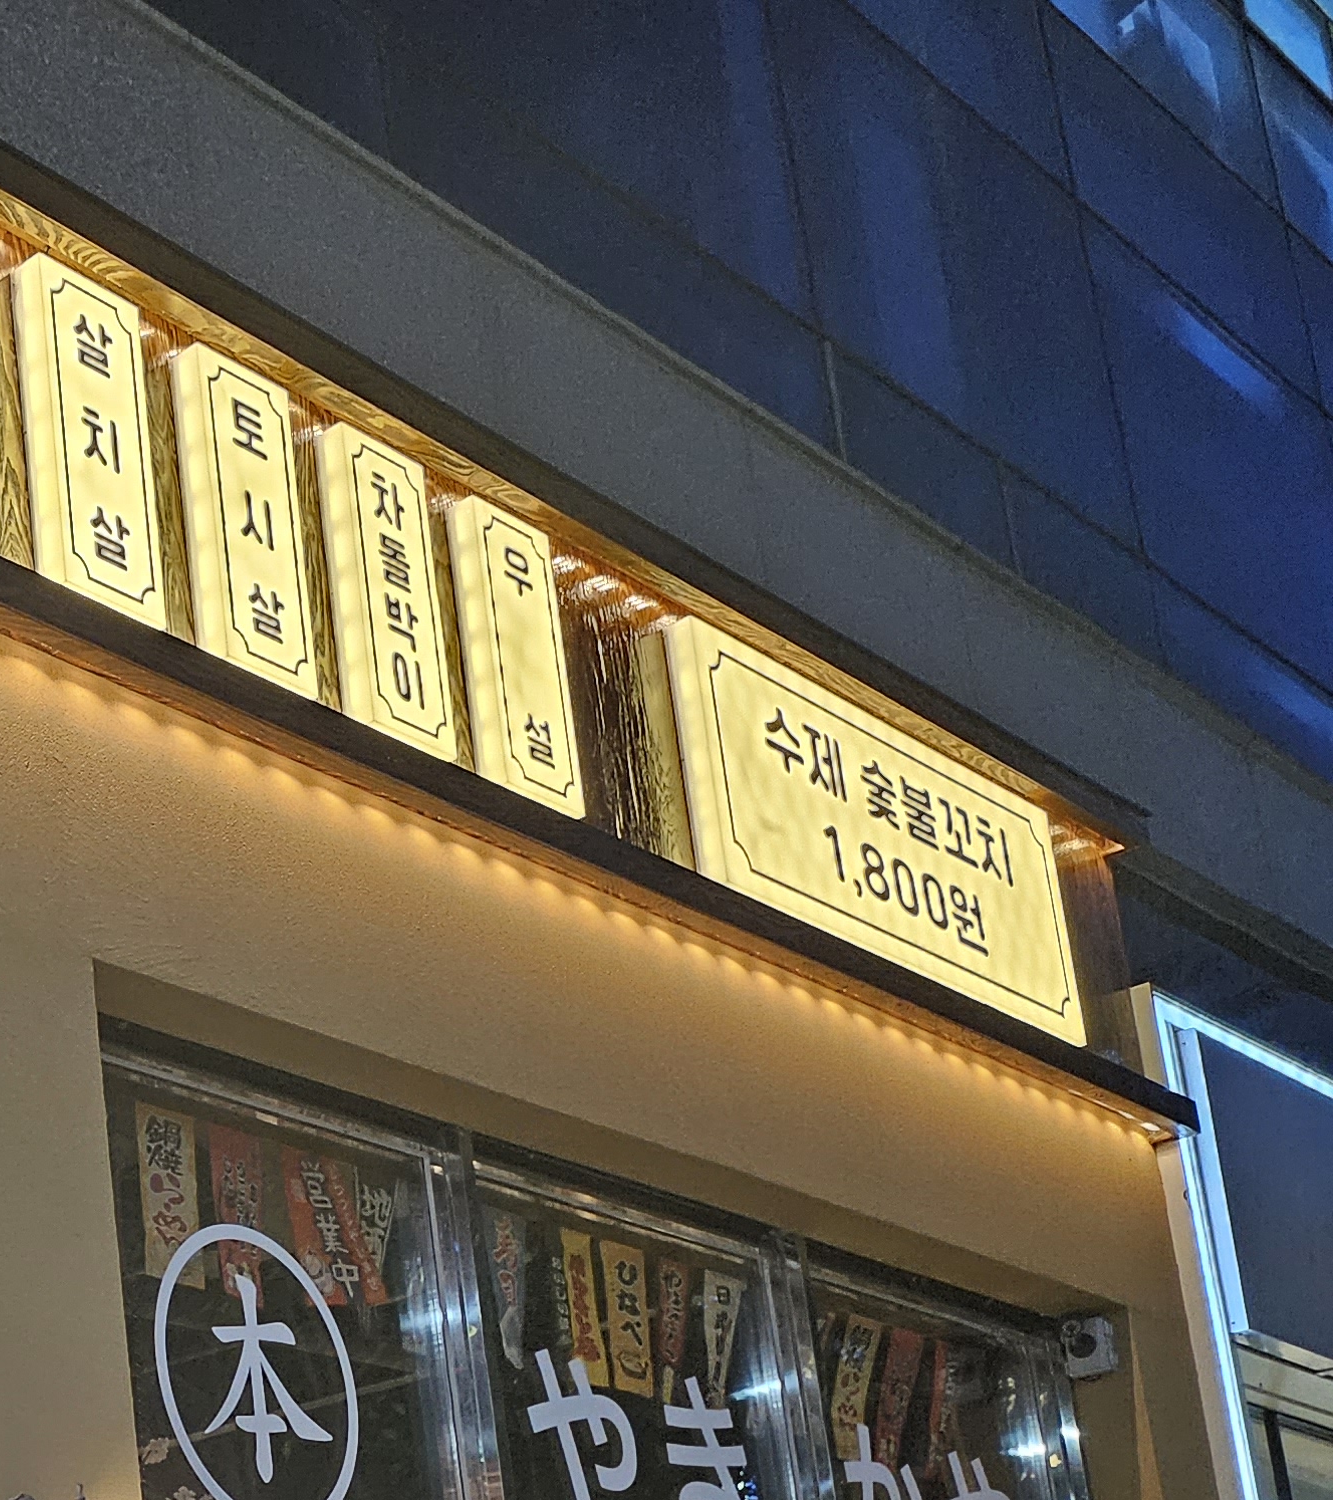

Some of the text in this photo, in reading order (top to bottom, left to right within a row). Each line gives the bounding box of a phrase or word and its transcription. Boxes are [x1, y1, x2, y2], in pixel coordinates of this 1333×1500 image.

[73, 314, 131, 572] 살치살
[230, 396, 286, 646] 토시살
[370, 471, 425, 711] 차돌박이
[502, 546, 558, 772] 우설
[764, 706, 1015, 888] 수제 숯불꼬치
[823, 824, 989, 958] 1,800원
[203, 1274, 333, 1484] 本
